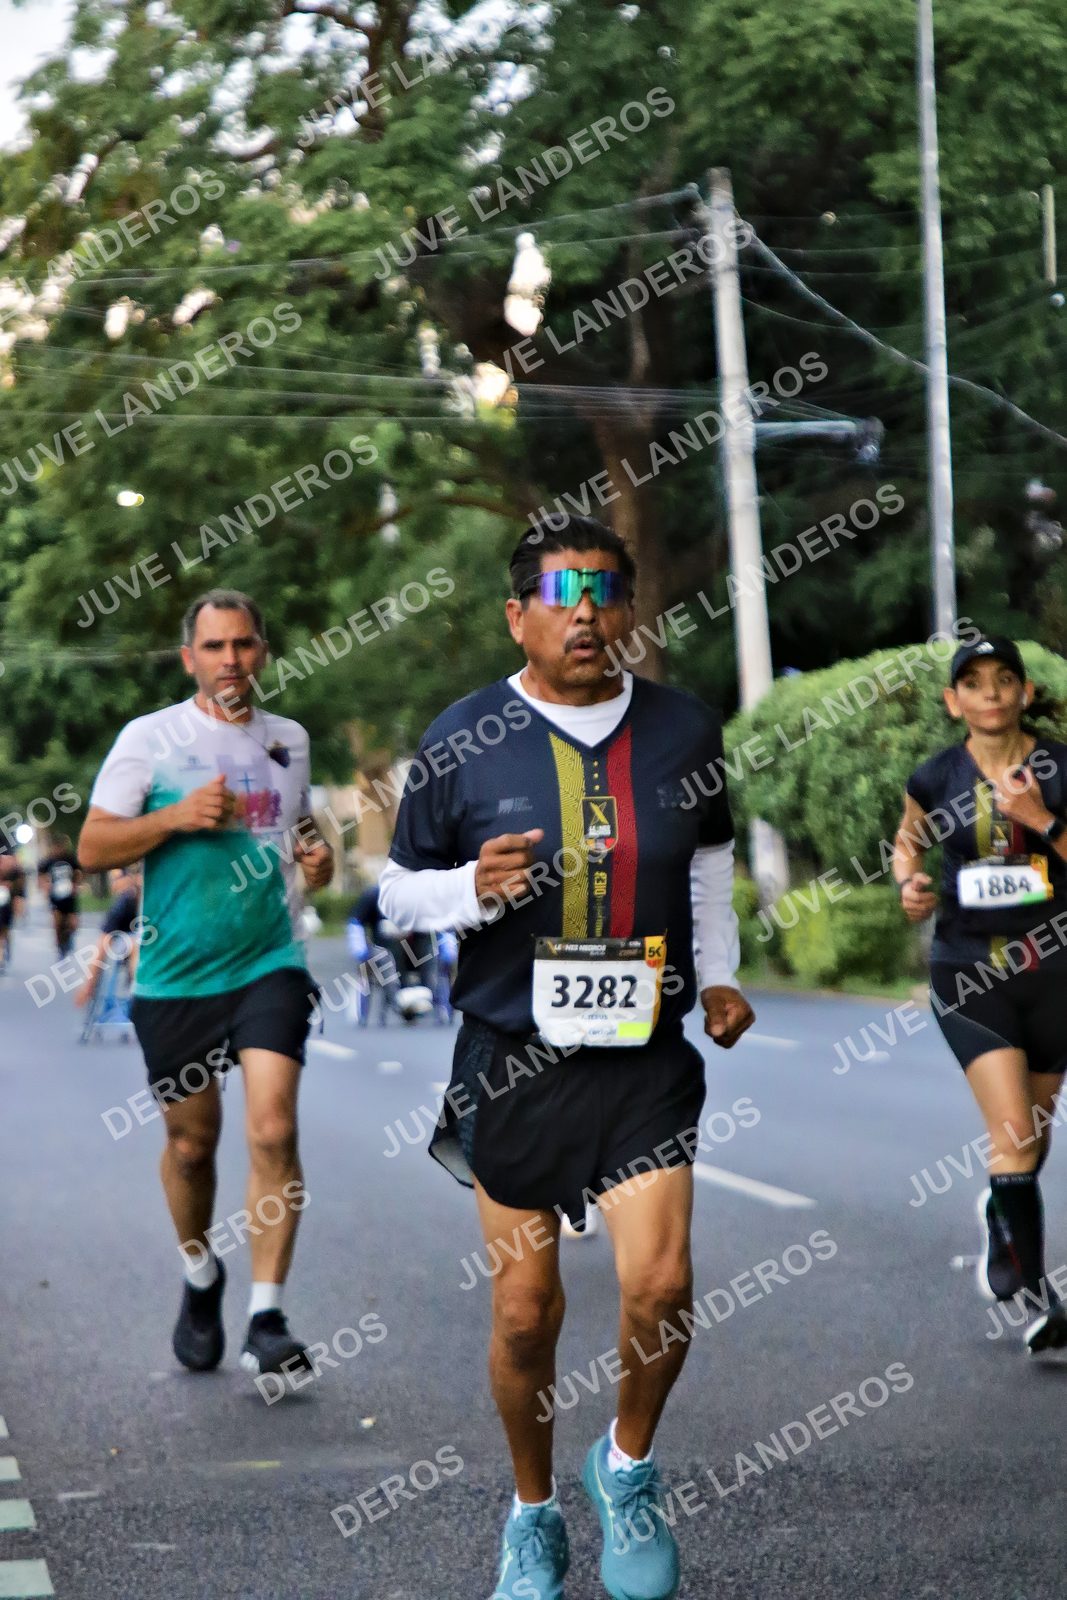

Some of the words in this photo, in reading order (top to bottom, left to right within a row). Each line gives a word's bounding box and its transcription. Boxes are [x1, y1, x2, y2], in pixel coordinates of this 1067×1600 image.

[974, 875, 1032, 899] 1884
[648, 946, 662, 958] 5K
[551, 974, 638, 1008] 3282
